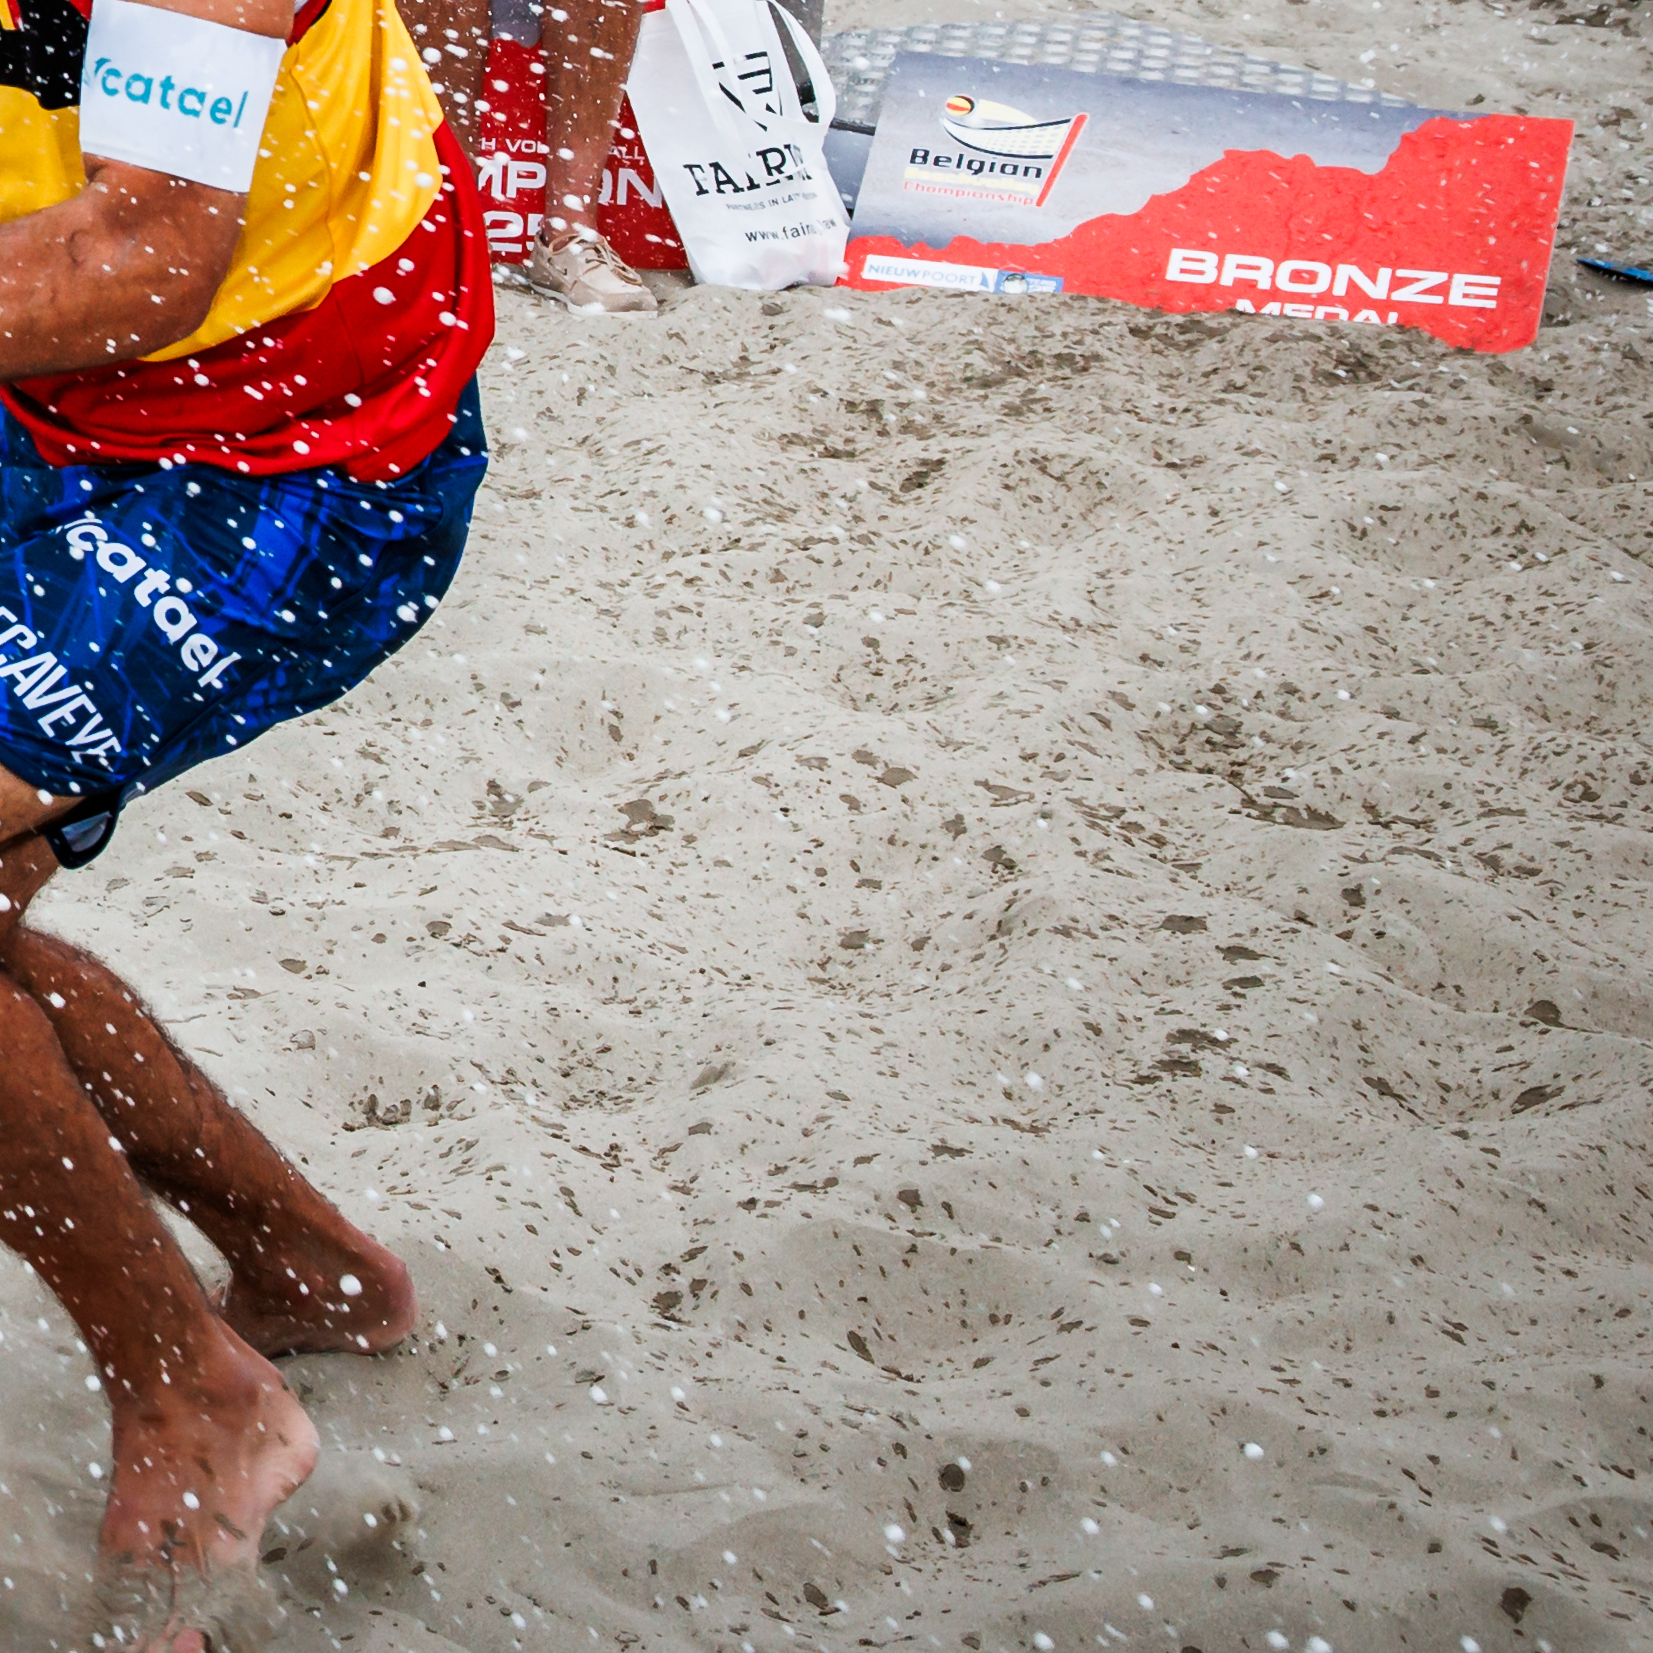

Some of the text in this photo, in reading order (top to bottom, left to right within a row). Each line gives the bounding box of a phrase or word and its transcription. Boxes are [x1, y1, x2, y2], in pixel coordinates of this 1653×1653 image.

[909, 148, 1043, 179] Belgian
[768, 197, 779, 207] IN
[903, 180, 1034, 206] Championship
[868, 263, 978, 285] NIEUWPOORT
[1165, 247, 1501, 309] BRONZE
